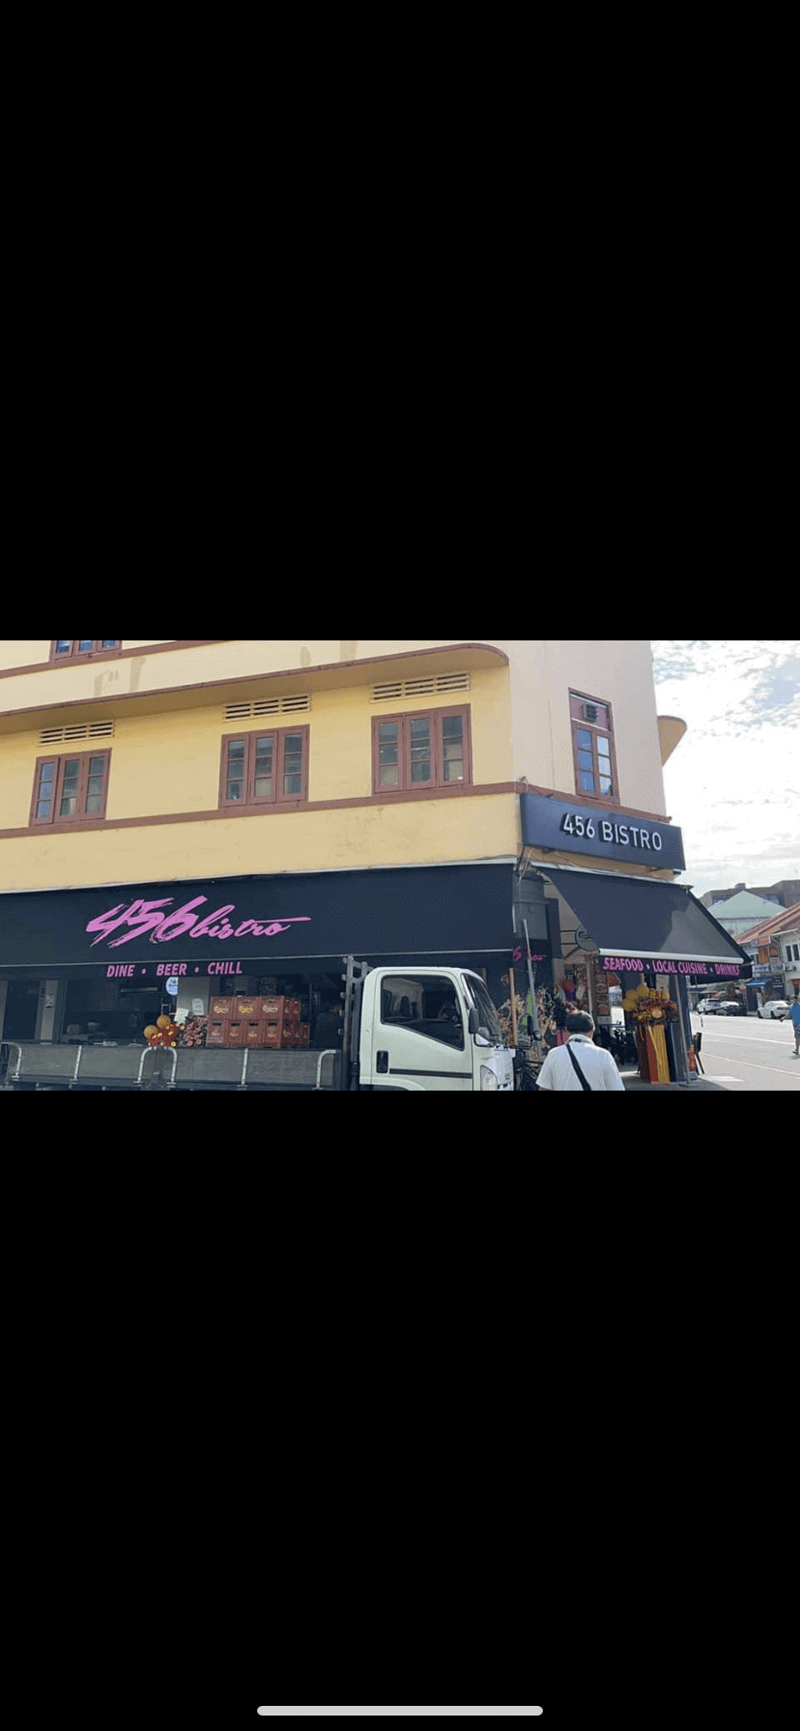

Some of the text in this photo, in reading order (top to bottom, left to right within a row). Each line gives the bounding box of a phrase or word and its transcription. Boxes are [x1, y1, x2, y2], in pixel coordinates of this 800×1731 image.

[563, 813, 662, 850] 456 BISTRO
[86, 895, 311, 948] 456 bistro
[106, 961, 243, 977] DINE BEER CHILL
[602, 956, 644, 972] SEAFOOD
[652, 960, 678, 974] LOCAL
[678, 961, 708, 975] CUISINE
[714, 963, 741, 976] DRINKS
